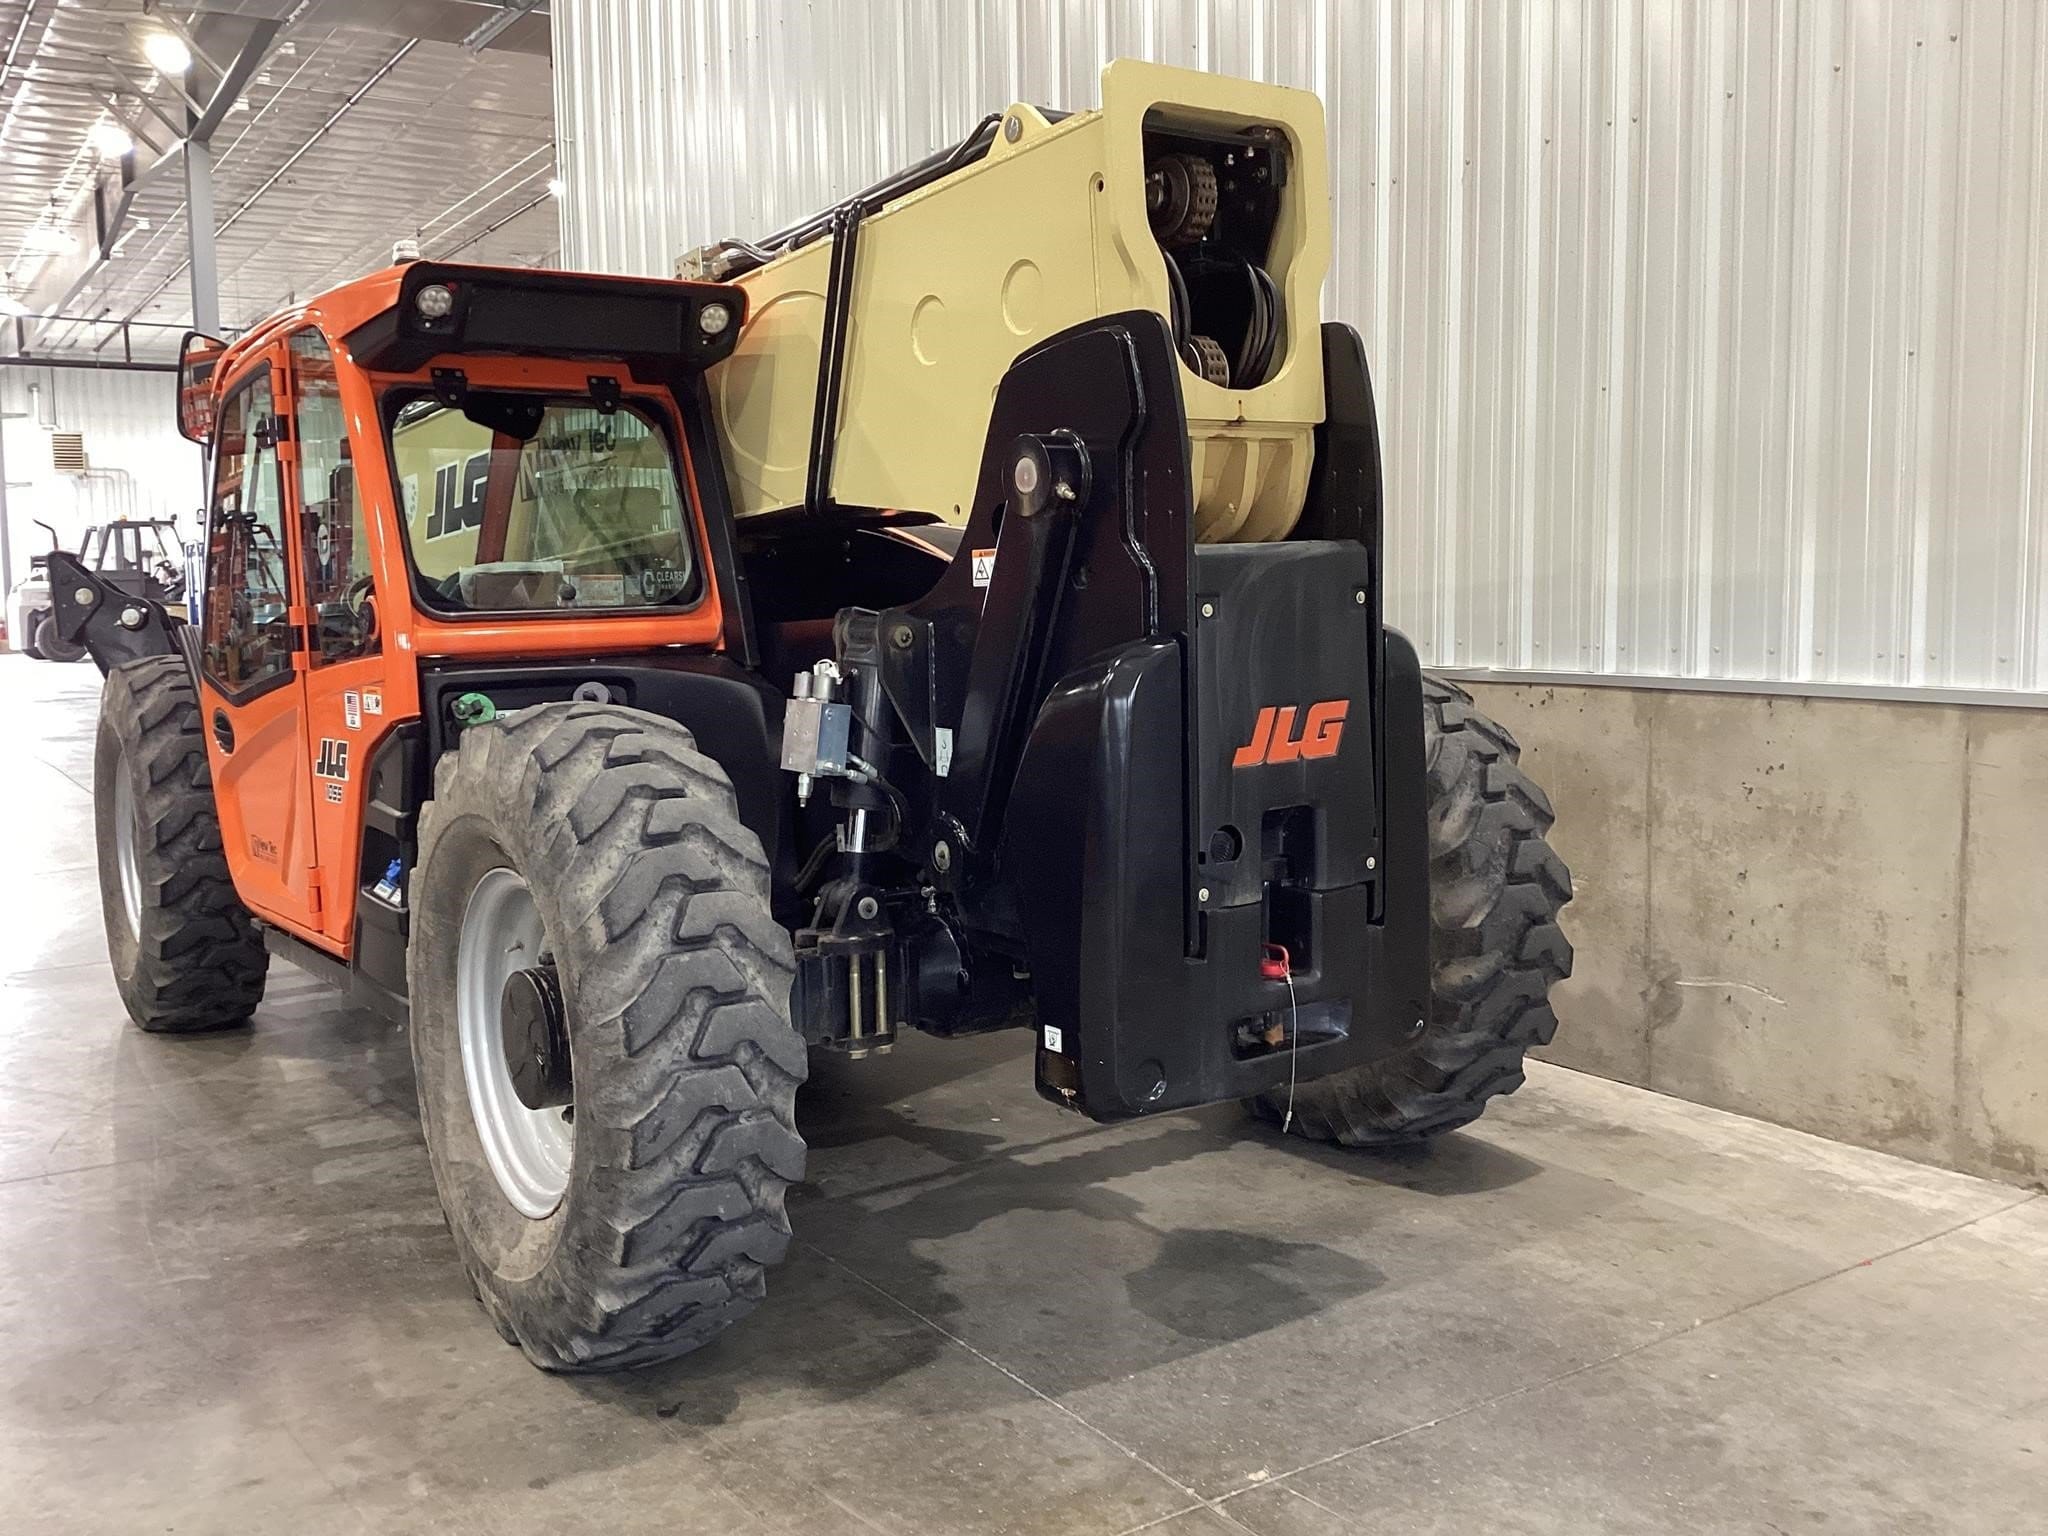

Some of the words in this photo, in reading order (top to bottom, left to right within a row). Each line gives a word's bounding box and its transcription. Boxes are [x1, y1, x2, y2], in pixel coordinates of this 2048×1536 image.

[426, 450, 490, 542] JLG
[315, 738, 349, 780] JLG
[1232, 700, 1349, 768] JLG
